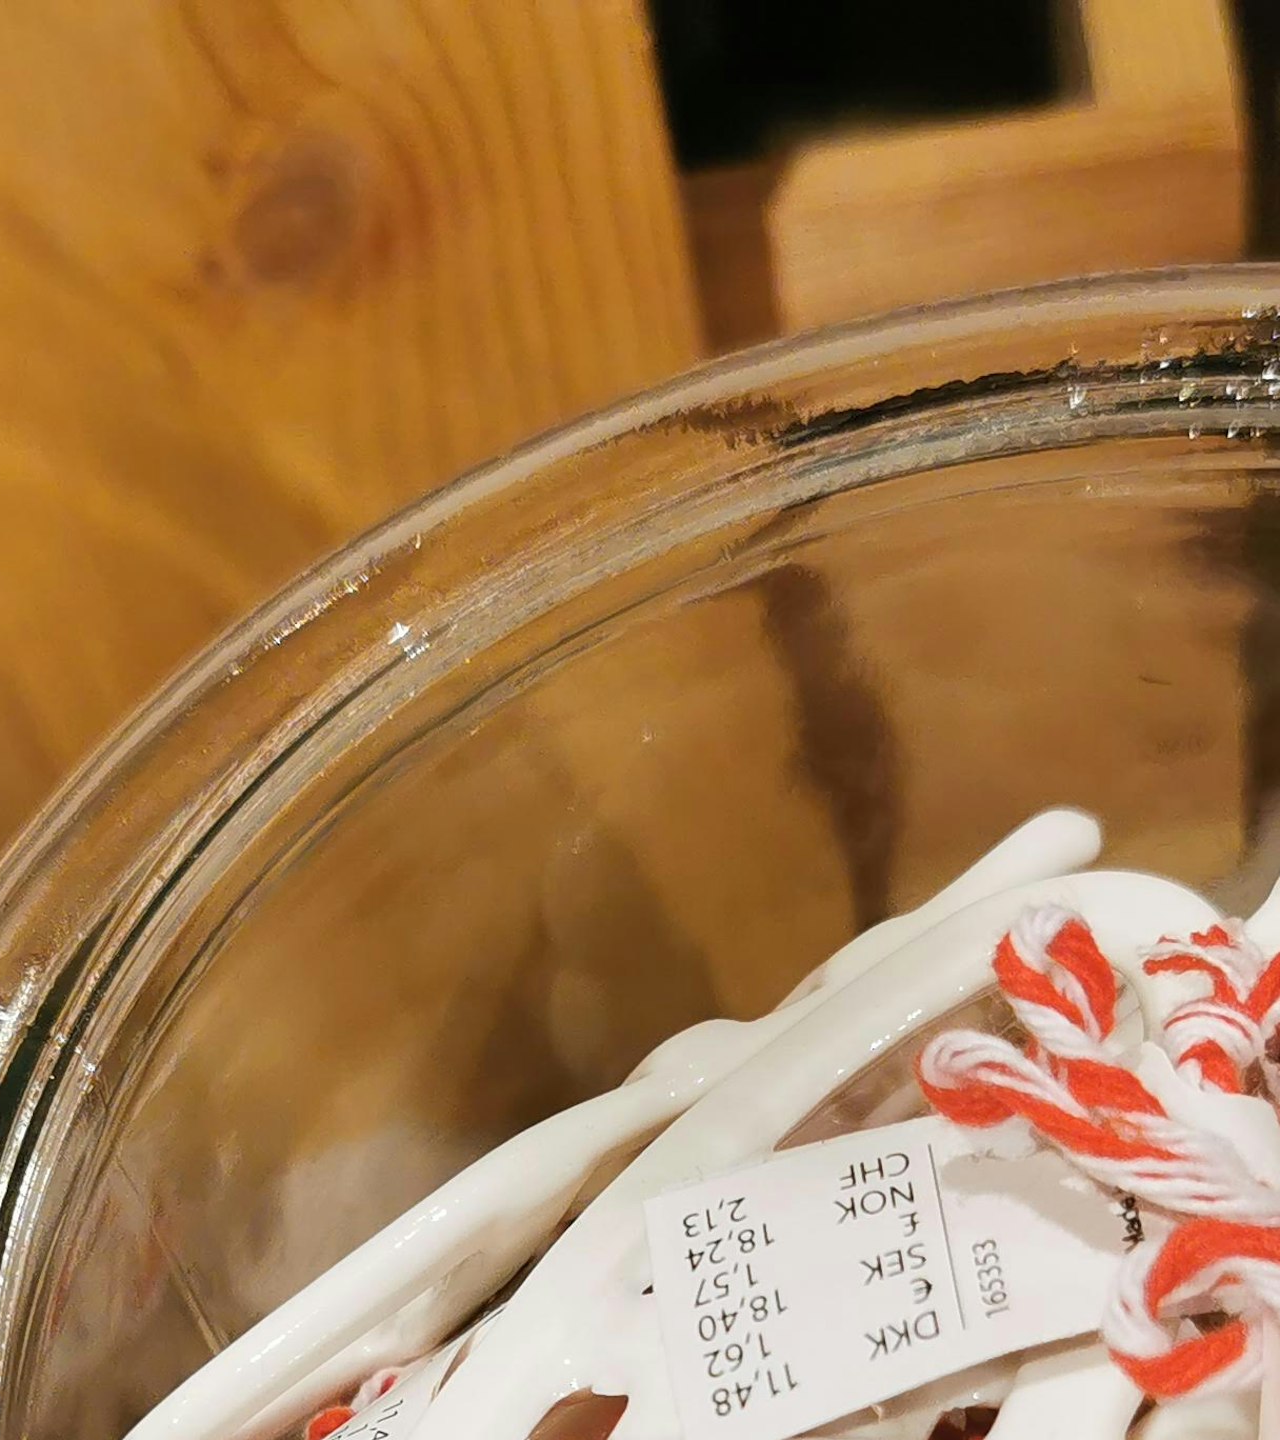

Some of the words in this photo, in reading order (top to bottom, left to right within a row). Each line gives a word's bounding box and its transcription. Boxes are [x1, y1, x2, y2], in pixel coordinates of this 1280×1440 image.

[839, 1152, 910, 1190] CHF
[682, 1197, 746, 1238] 2,13
[834, 1182, 915, 1224] NOK
[898, 1212, 920, 1237] £
[685, 1223, 775, 1272] 18,24
[860, 1243, 928, 1285] SEK
[694, 1263, 760, 1307] 1,57
[910, 1278, 933, 1304] €
[972, 1239, 1010, 1319] 165353
[698, 1289, 788, 1341] 18,40
[865, 1310, 940, 1361] DKK
[703, 1333, 772, 1379] 1,62
[712, 1362, 799, 1417] 11,48
